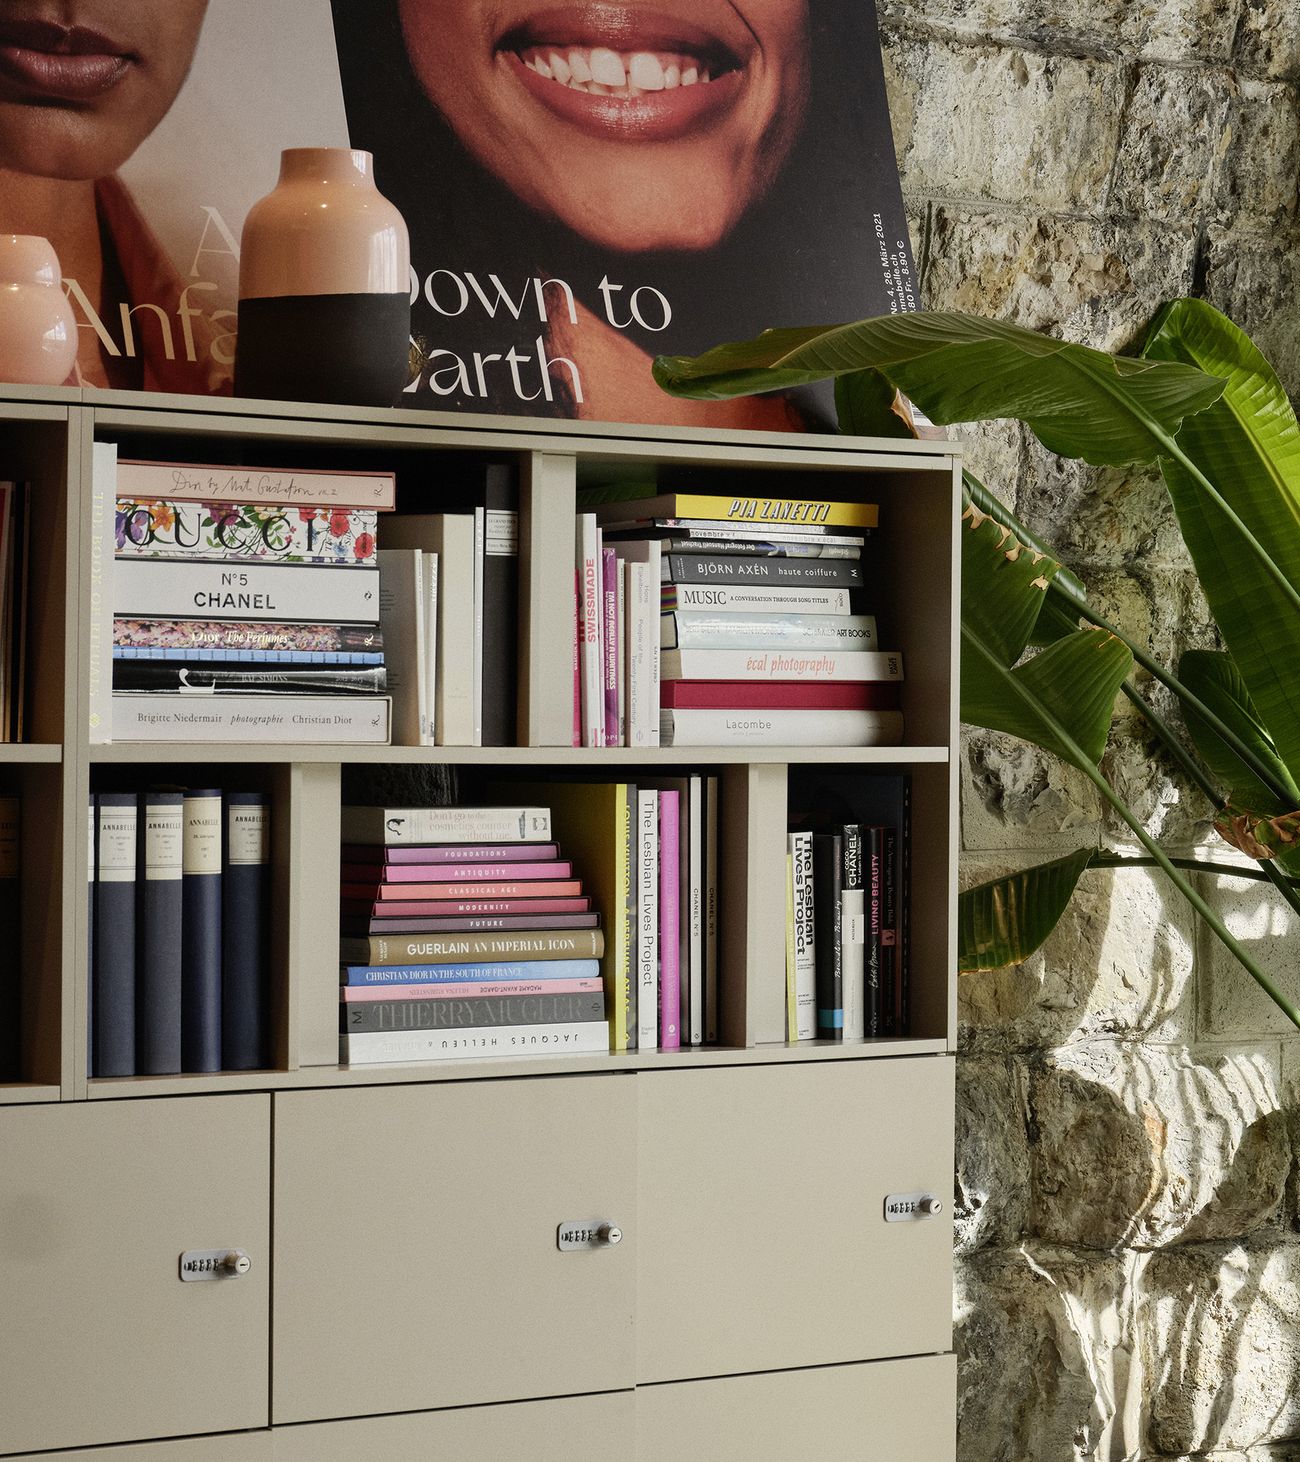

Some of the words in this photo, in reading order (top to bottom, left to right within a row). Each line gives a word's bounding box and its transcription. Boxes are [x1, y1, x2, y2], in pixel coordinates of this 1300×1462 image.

[873, 212, 885, 239] 2021
[880, 240, 890, 267] März
[409, 268, 578, 324] own
[598, 274, 672, 332] to
[403, 334, 585, 404] arth
[727, 499, 755, 518] PIA
[760, 500, 831, 522] ZANETTI
[122, 509, 315, 552] GUCCI
[697, 562, 733, 577] BJÖRN
[738, 564, 769, 577] AXÉN
[778, 567, 801, 576] haute
[805, 568, 838, 577] coiffure
[193, 592, 277, 610] CHANEL
[586, 558, 596, 643] SWISSMADE
[684, 590, 727, 605] MUSIC
[246, 631, 289, 644] Perfumes
[836, 630, 848, 638] ART
[848, 630, 871, 638] BOOKS
[746, 654, 767, 671] écal
[771, 655, 836, 676] photography
[137, 712, 171, 724] Brigitte
[173, 712, 222, 723] Niedermair
[230, 713, 284, 725] photographie
[292, 714, 331, 724] Christian
[334, 715, 352, 725] Dior
[726, 719, 771, 730] Lacombe
[189, 818, 219, 827] ANNABELLE
[644, 799, 654, 828] The
[643, 833, 654, 889] Lesbian
[795, 837, 803, 885] Lives
[804, 836, 813, 871] The
[849, 835, 857, 886] CHANEL
[454, 869, 507, 877] ANTIQUITY
[871, 854, 879, 896] BEAUTY
[643, 894, 654, 931] Lives
[796, 889, 806, 955] Project
[804, 875, 814, 946] Lesbian
[871, 900, 879, 935] LIVING
[407, 942, 469, 956] GUERLAIN
[473, 944, 487, 954] AN
[491, 940, 546, 953] IMPERIAL
[548, 938, 576, 951] ICON
[365, 971, 408, 981] CHRISTIAN
[409, 971, 428, 980] DIOR
[429, 970, 438, 979] IN
[439, 969, 454, 979] THE
[455, 969, 478, 978] SOUTH
[479, 968, 490, 977] OF
[491, 967, 523, 977] FRANCE
[641, 936, 654, 986] Project
[373, 1001, 474, 1029] THIERRY
[442, 1038, 498, 1047] HELLEU
[511, 1034, 578, 1045] JACQUES
